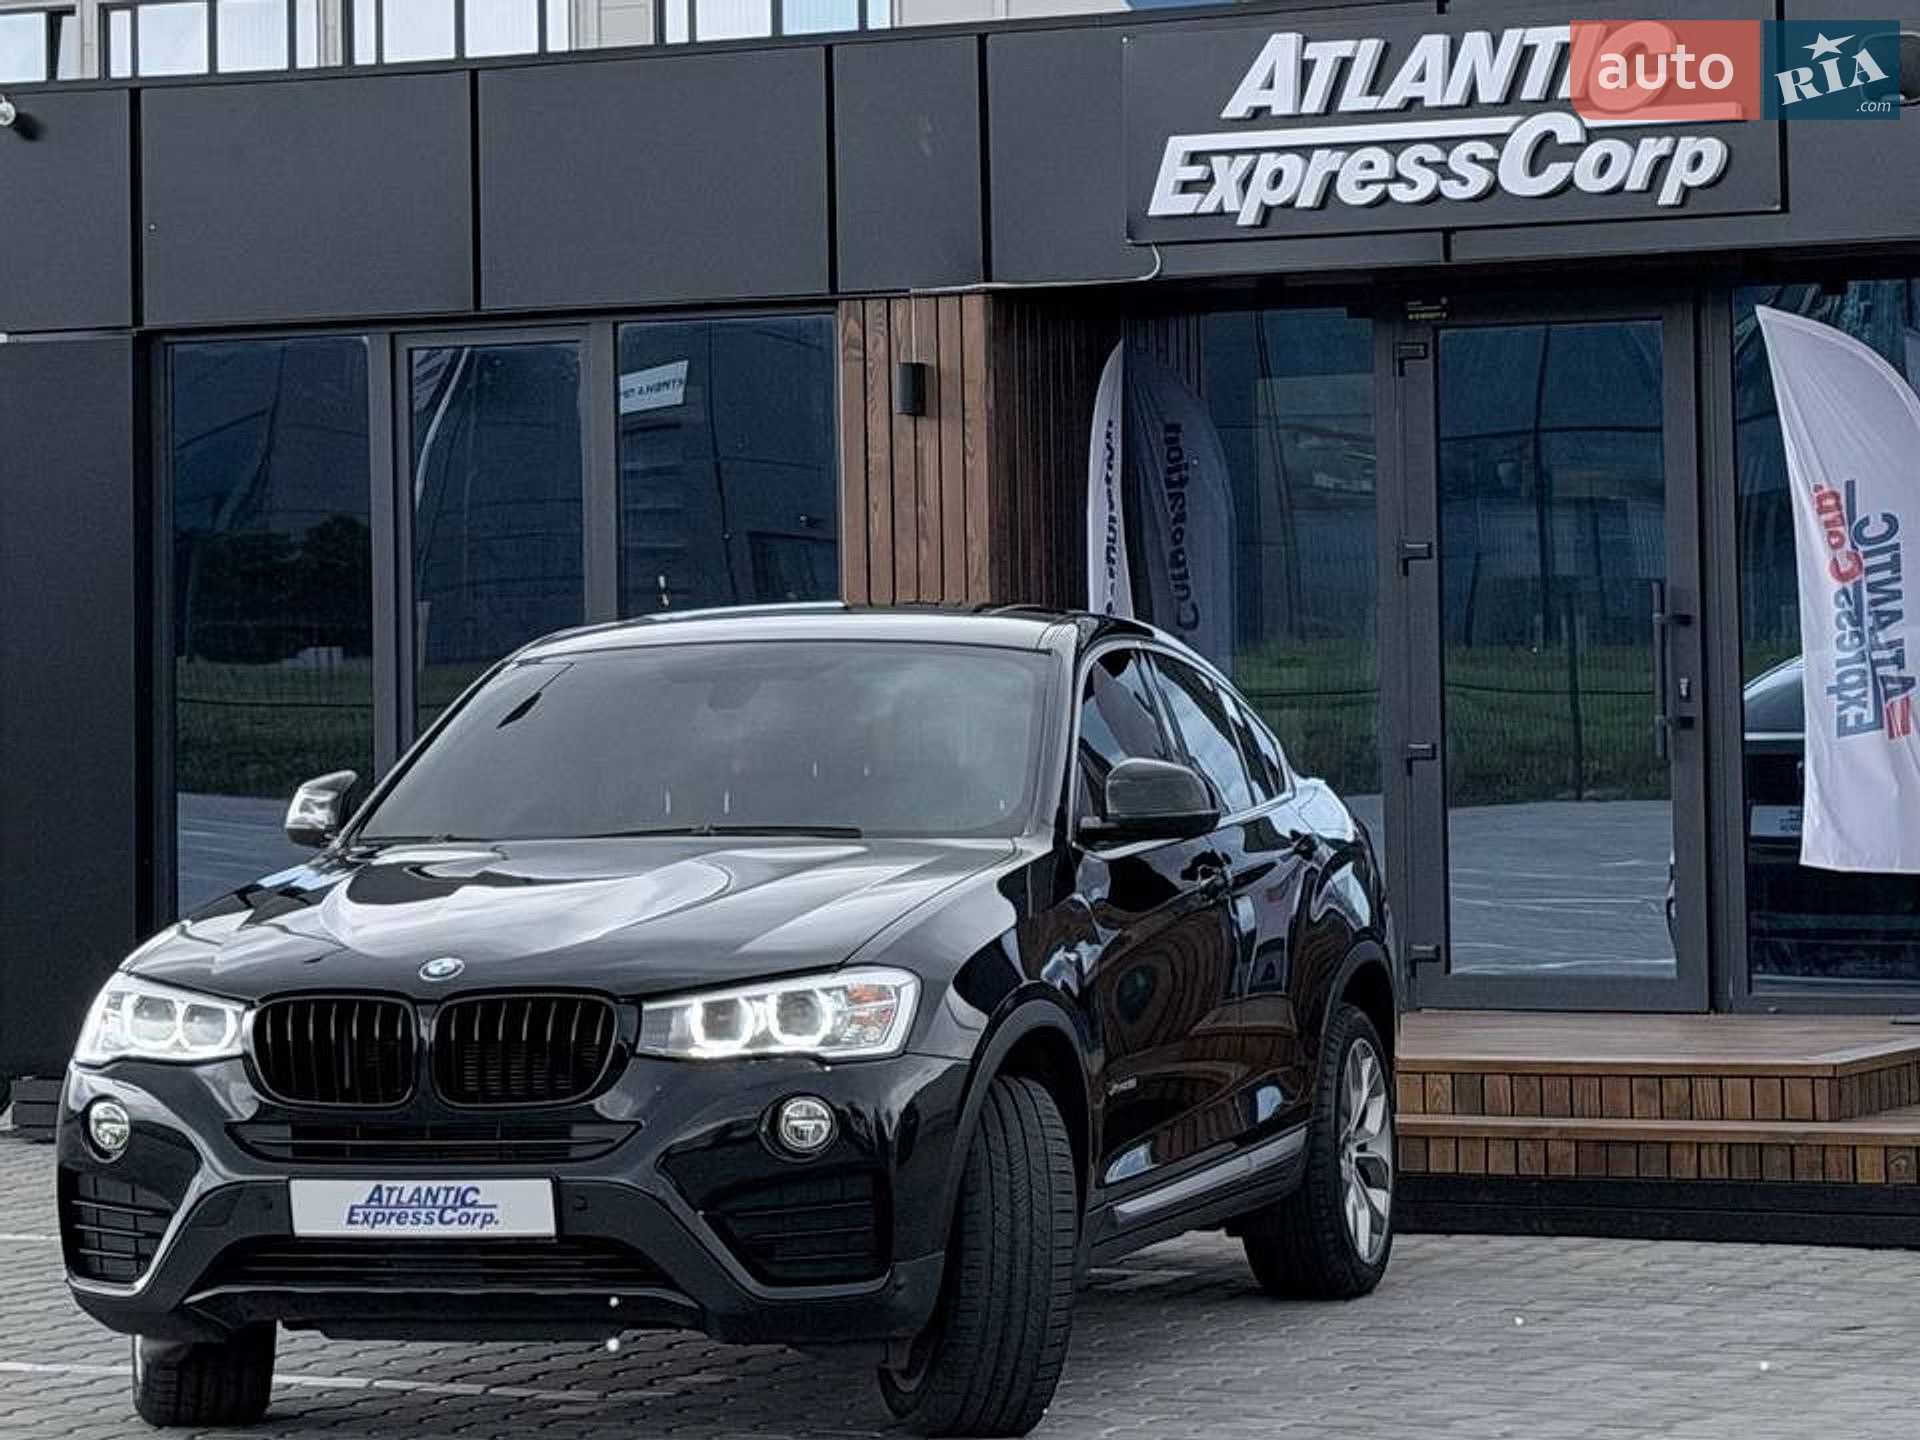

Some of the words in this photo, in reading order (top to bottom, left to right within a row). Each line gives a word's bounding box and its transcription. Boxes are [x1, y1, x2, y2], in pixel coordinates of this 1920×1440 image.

[1220, 20, 1677, 120] ATLANTIC
[1148, 111, 1731, 227] ExpressCorp
[346, 1204, 500, 1229] ExpressCorp.
[365, 1184, 480, 1206] ATLANTIC
